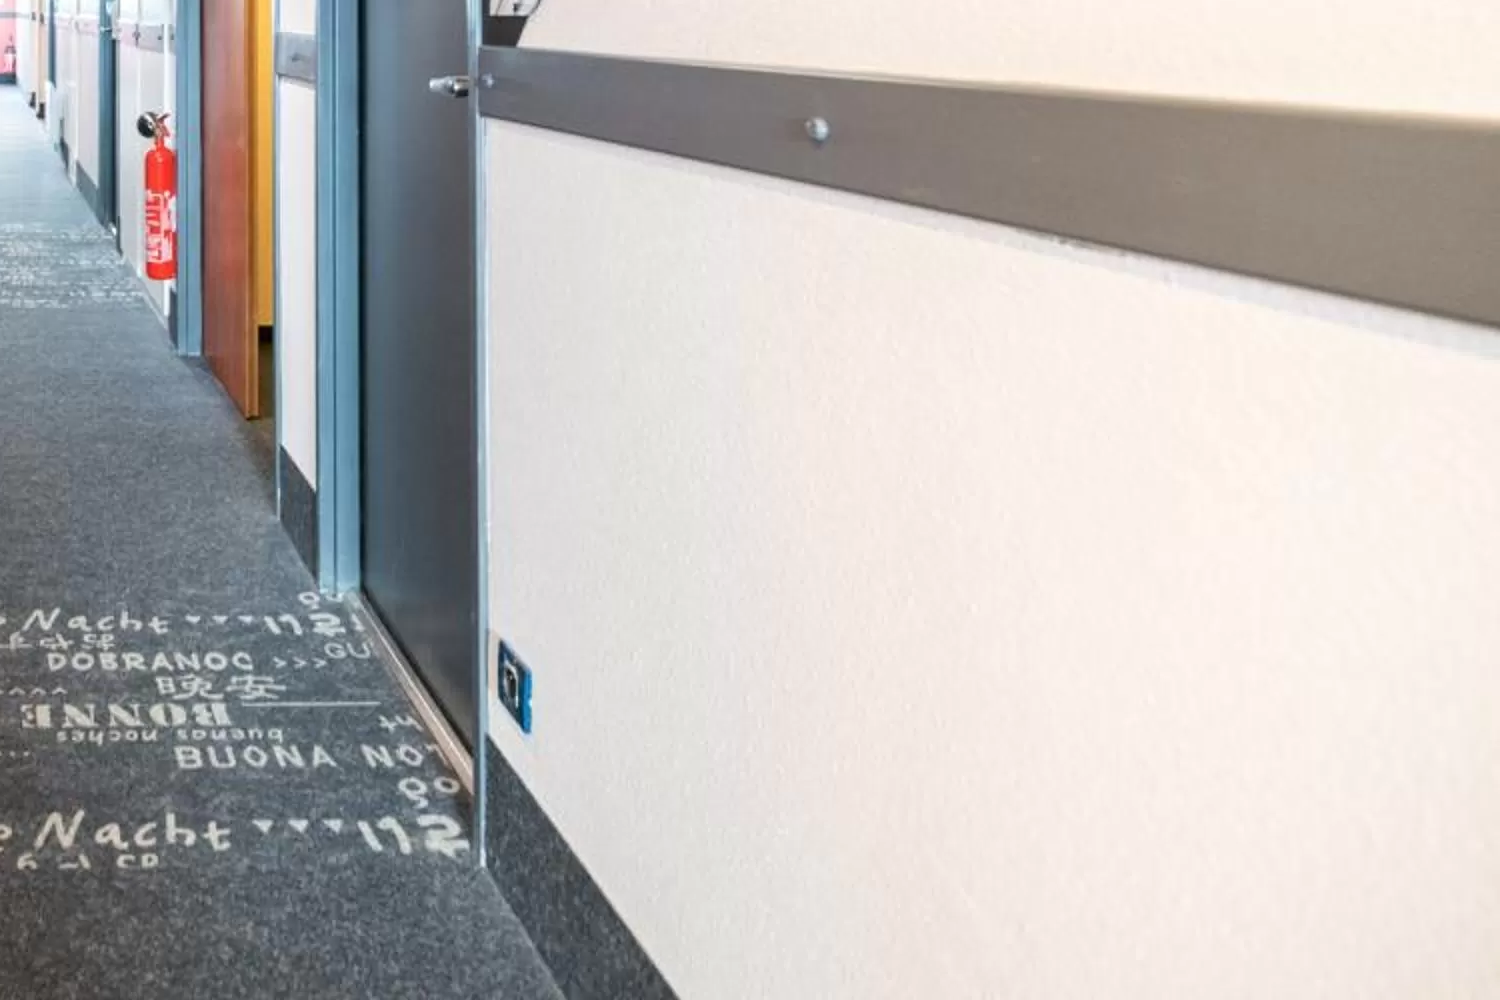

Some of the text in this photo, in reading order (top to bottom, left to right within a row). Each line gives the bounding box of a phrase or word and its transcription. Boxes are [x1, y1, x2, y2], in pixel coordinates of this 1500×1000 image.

[21, 607, 169, 635] Nacht
[47, 651, 253, 672] DOBRANOC
[20, 702, 232, 728] BONNE
[56, 730, 157, 746] noches
[174, 744, 338, 768] BUONA
[33, 808, 232, 852] Nacht
